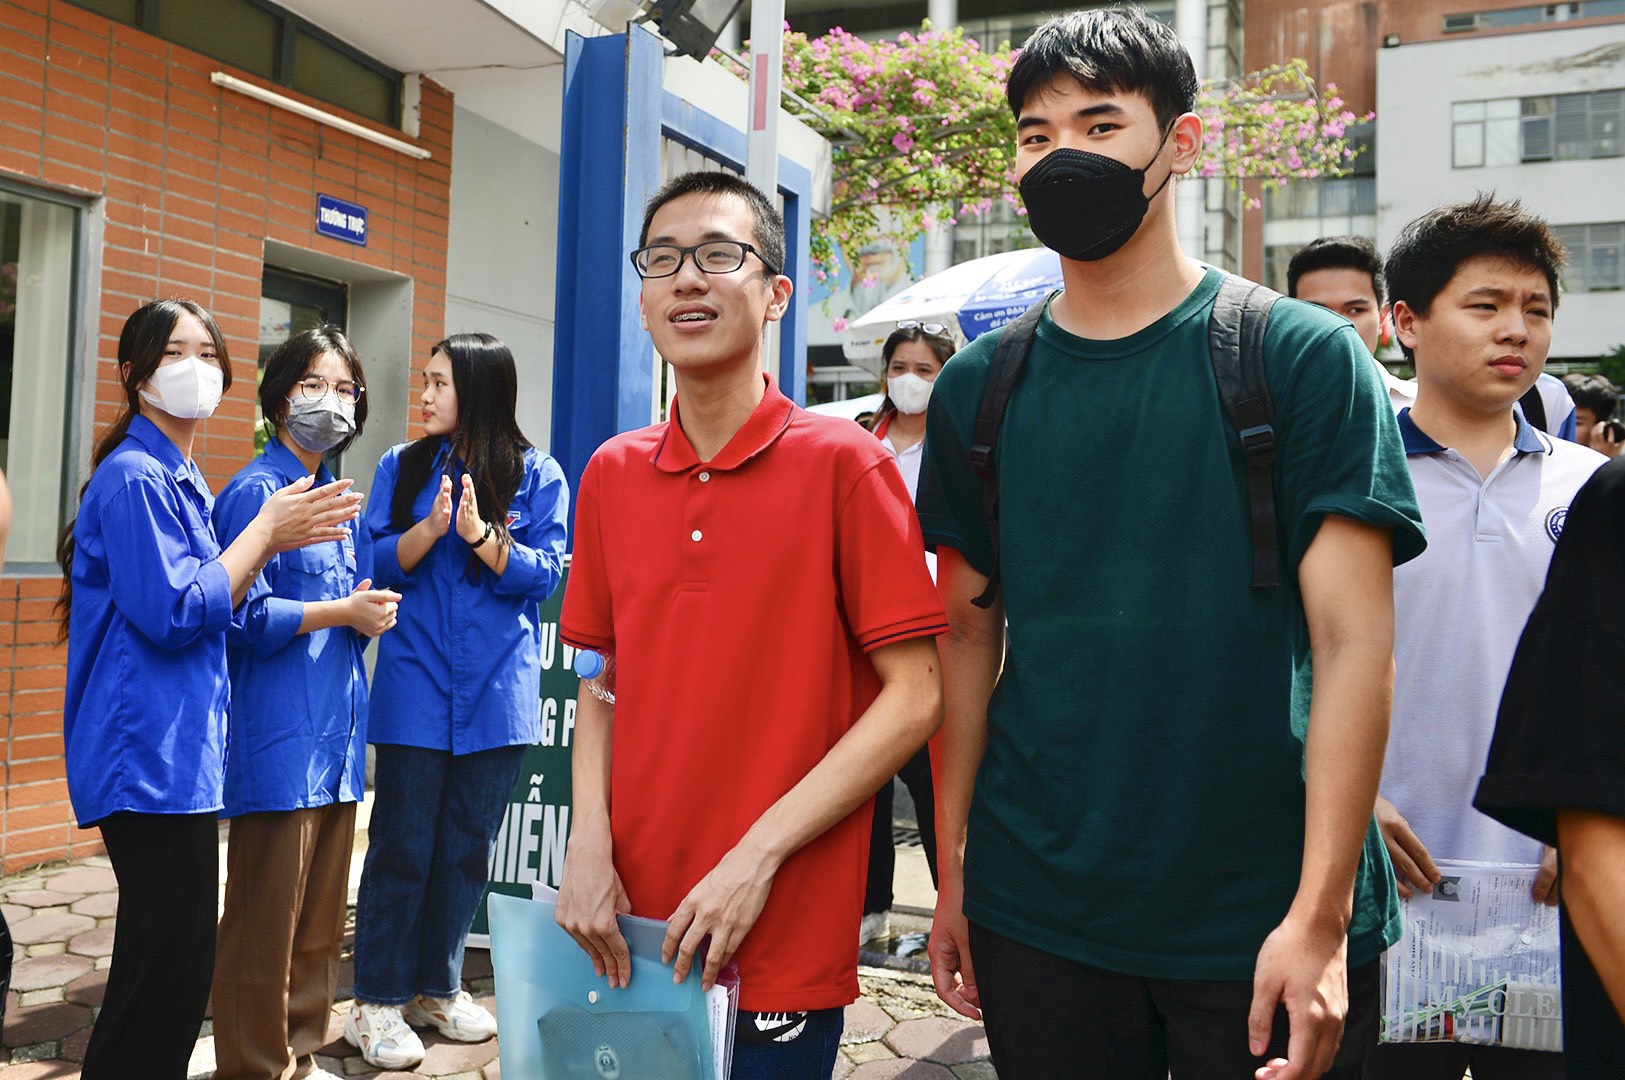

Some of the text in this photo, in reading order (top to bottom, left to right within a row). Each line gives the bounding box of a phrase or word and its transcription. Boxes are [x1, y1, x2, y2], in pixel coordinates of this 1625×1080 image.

[538, 622, 557, 670] U
[533, 697, 557, 747] G
[1487, 988, 1561, 1019] CLE
